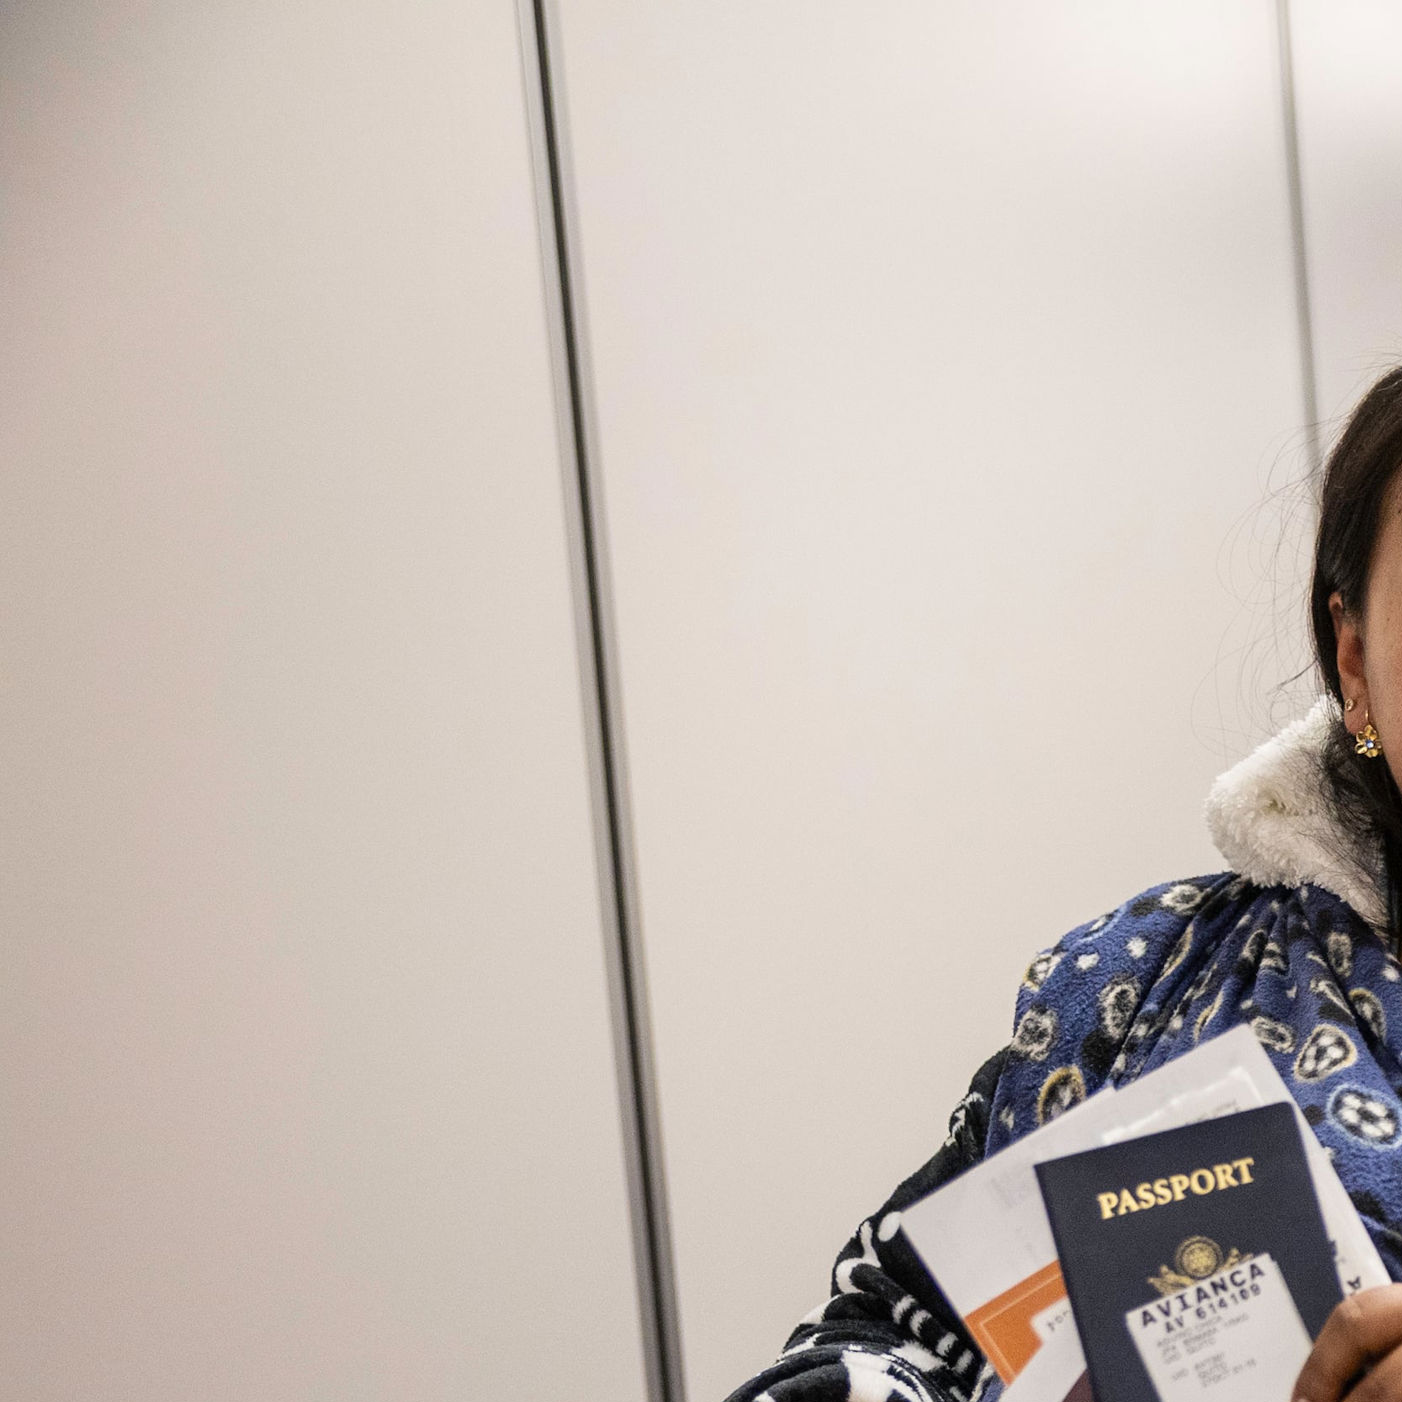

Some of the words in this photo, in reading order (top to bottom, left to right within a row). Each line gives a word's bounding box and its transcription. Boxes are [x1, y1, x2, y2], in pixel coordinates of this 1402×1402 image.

[1096, 1157, 1255, 1220] PASSPORT
[1141, 1262, 1266, 1328] AVIANCA
[1164, 1315, 1185, 1334] AV
